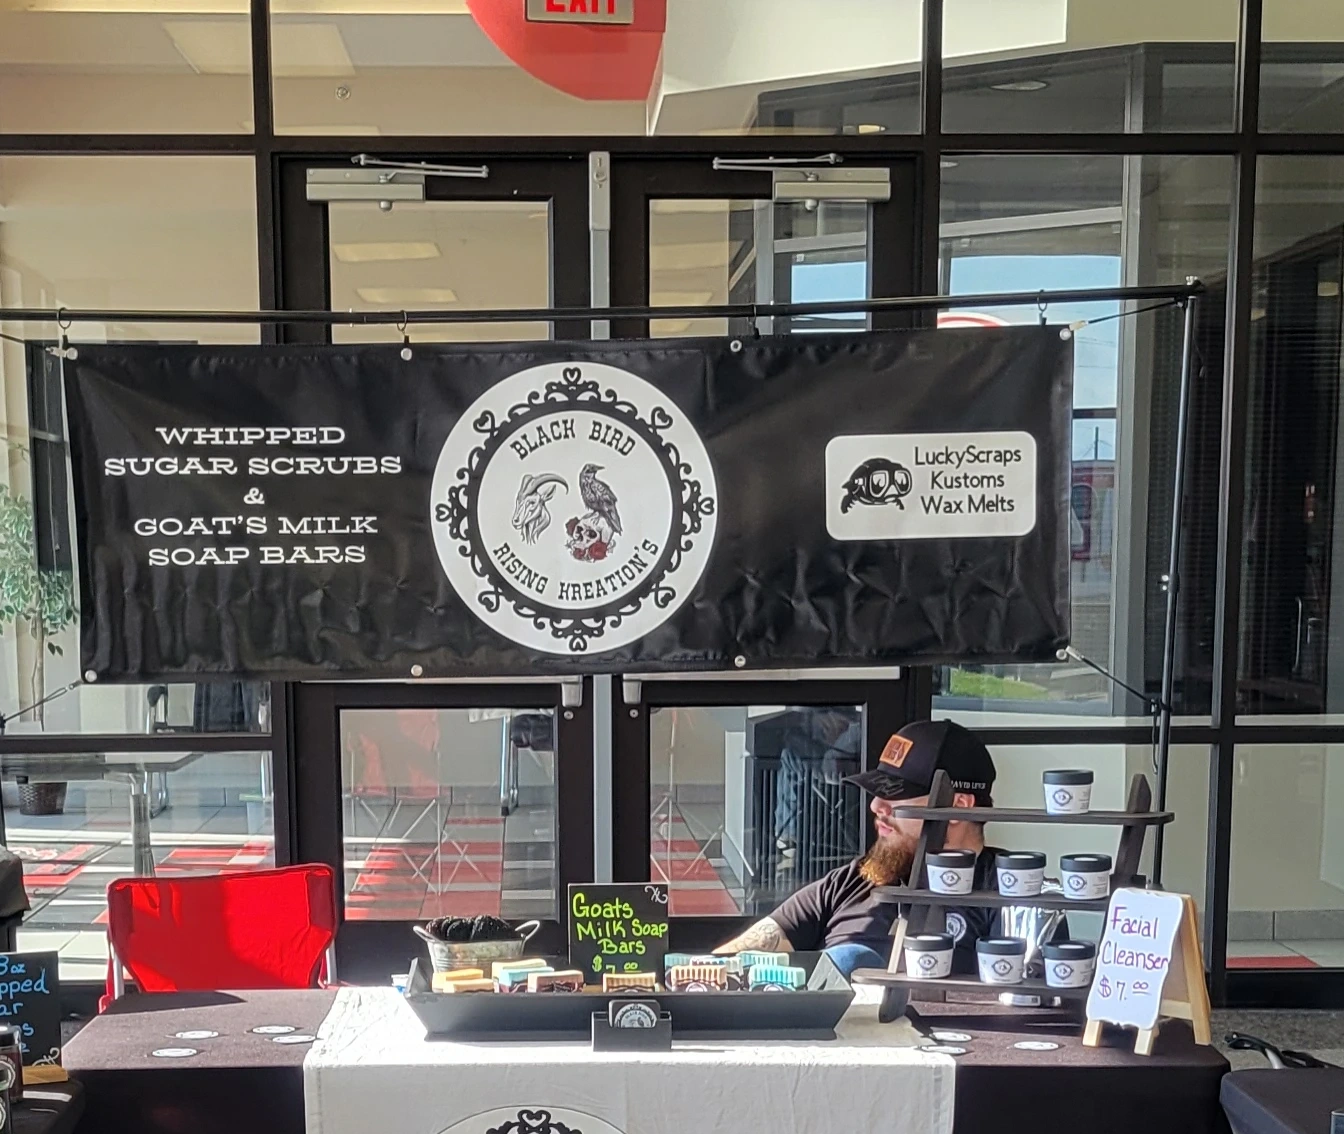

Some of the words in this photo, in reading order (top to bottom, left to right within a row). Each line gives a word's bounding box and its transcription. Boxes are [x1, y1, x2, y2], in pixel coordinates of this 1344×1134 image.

[156, 427, 346, 445] WHIPPED
[509, 418, 576, 461] BLACK
[588, 419, 637, 457] BIRD
[104, 457, 238, 477] SUGAR
[248, 455, 402, 475] SCRUBS
[914, 445, 1022, 469] LuckyScraps
[930, 471, 1004, 490] Kustoms
[243, 487, 265, 504] &
[920, 496, 964, 514] Wax
[968, 494, 1015, 513] Melts
[134, 516, 268, 536] GOAT'S
[278, 515, 378, 534] MILK
[148, 547, 249, 566] SOAP
[260, 545, 366, 564] BARS
[492, 541, 549, 596] RISING
[573, 893, 634, 918] Goats
[576, 920, 626, 941] Milk
[631, 918, 668, 938] Soap
[1111, 906, 1158, 939] Facial
[597, 938, 646, 955] Bars
[1101, 940, 1169, 970] Cleanser
